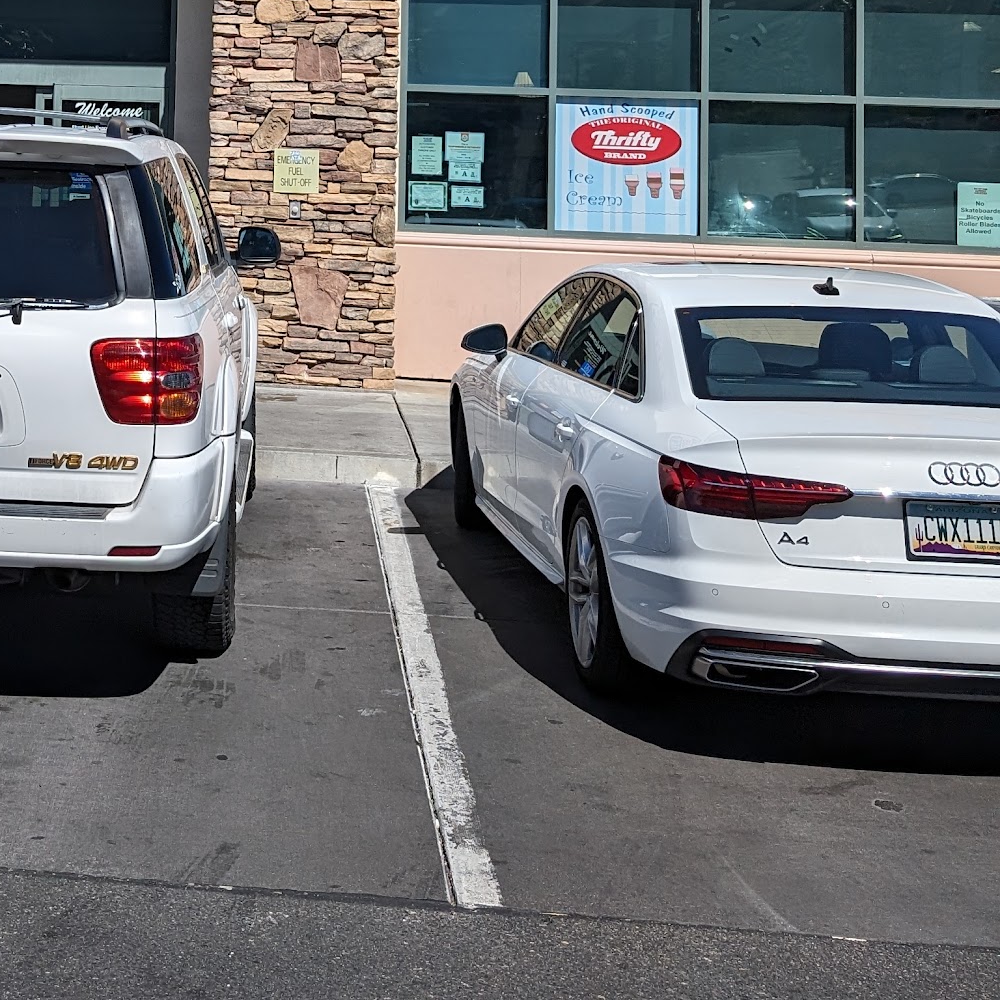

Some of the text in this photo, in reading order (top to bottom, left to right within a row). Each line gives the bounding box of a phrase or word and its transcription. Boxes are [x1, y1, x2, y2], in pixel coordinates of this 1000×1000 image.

[75, 102, 144, 117] Welcome
[579, 102, 676, 121] Hand Scooped
[588, 117, 663, 131] THE ORIGINAL
[590, 129, 662, 151] Thrifty
[603, 152, 647, 160] BRAND
[288, 166, 304, 176] FUEL
[568, 169, 594, 184] Ice
[280, 177, 312, 187] SHUT-OFF
[566, 191, 623, 206] Cream
[53, 452, 82, 469] V8
[87, 455, 139, 470] 4WD
[935, 505, 988, 515] ARIZONA
[777, 531, 810, 545] A4
